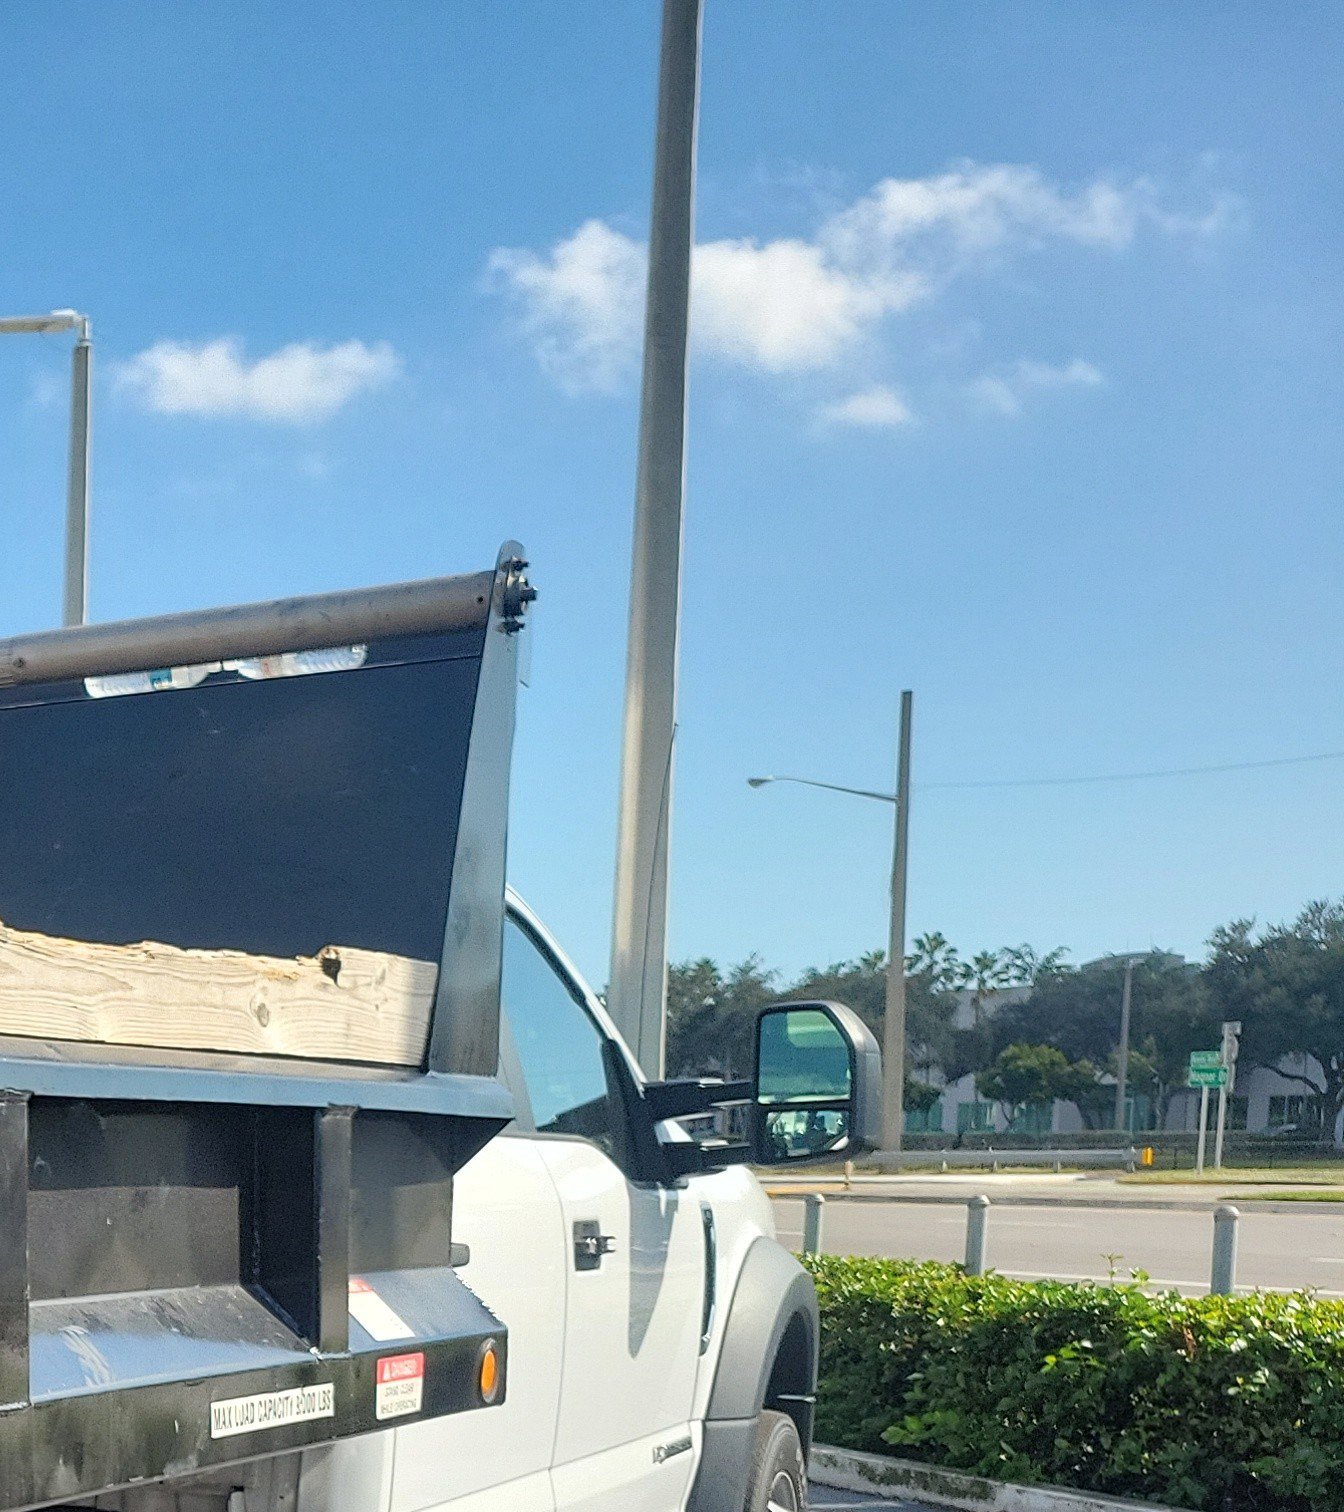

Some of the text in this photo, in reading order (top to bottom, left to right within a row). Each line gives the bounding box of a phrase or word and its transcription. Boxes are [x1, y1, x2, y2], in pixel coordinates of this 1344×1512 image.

[213, 1406, 232, 1430] MAX
[235, 1402, 255, 1427] LOAD
[258, 1395, 294, 1423] CAPACITY
[318, 1389, 331, 1411] LBS
